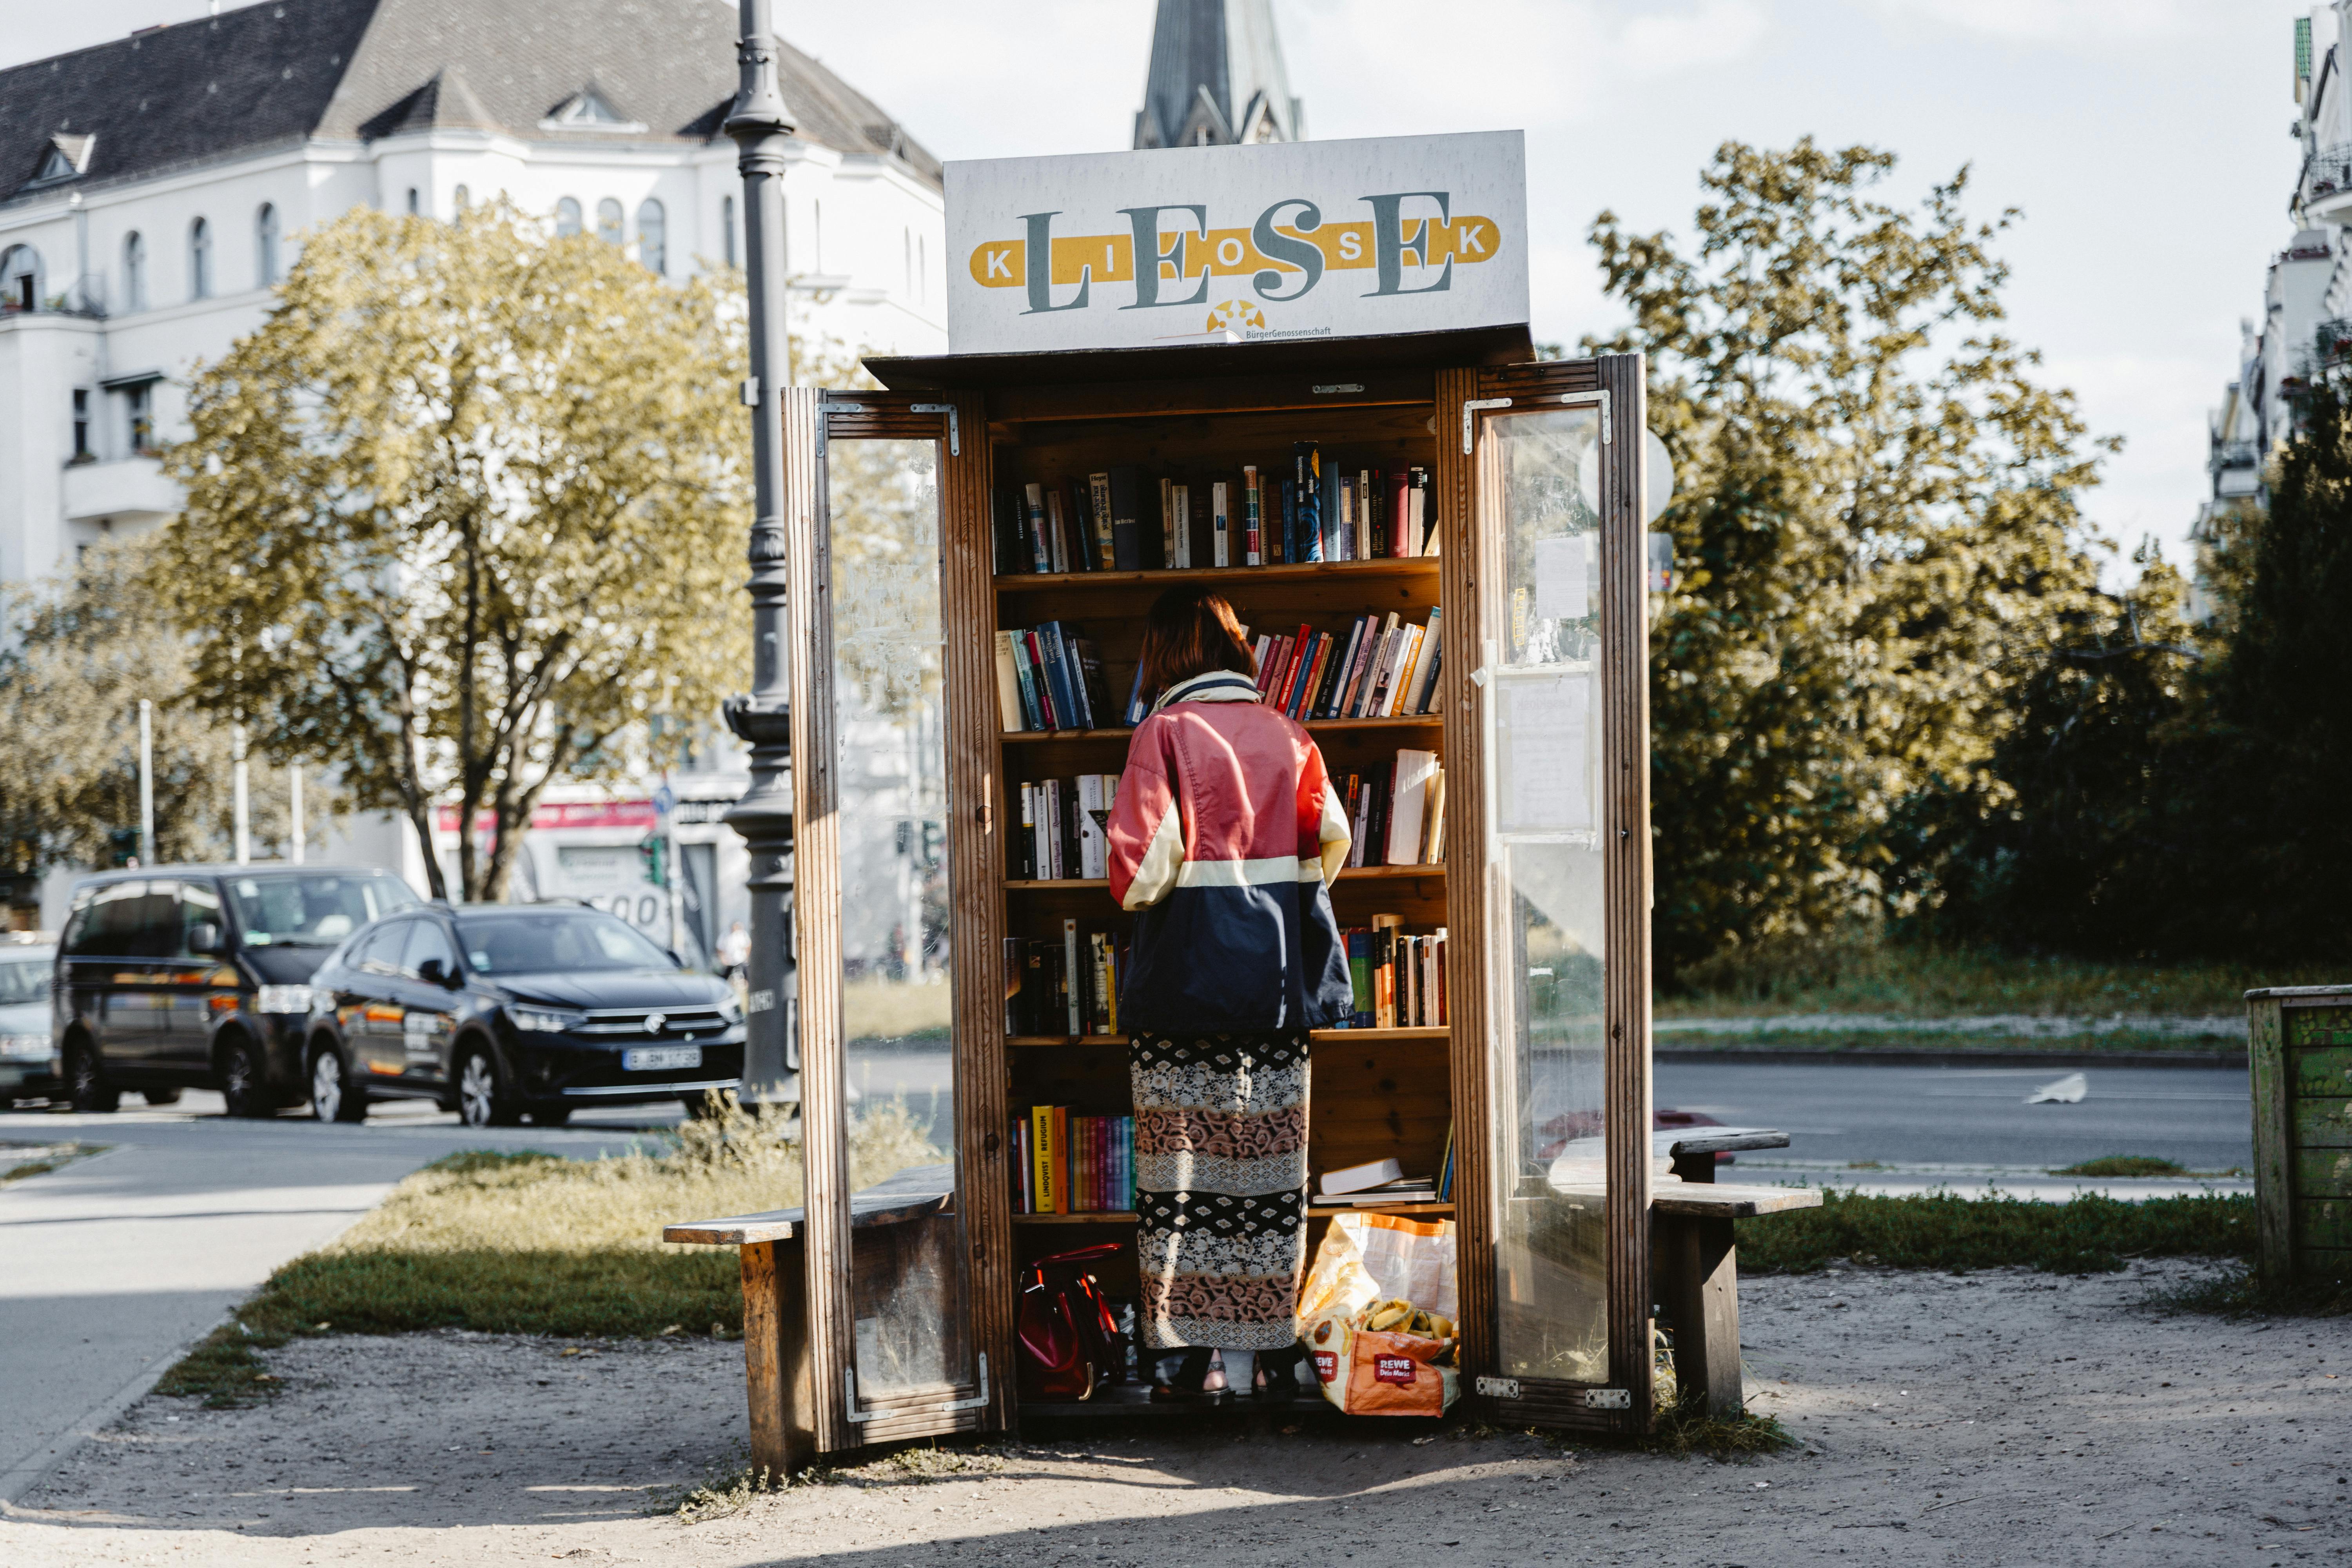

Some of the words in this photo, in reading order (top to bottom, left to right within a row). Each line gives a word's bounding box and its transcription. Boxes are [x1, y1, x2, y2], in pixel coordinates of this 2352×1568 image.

[1016, 191, 1451, 315] LESE
[1247, 327, 1331, 340] BürgerGenossenschaft
[1363, 637, 1372, 653] Wüste!
[1426, 625, 1438, 645] GOOD
[1045, 631, 1056, 663] Entdeckung
[1274, 649, 1289, 680] Skandale
[1287, 670, 1295, 685] kommen
[1398, 675, 1409, 699] Freiheitsstatue
[1410, 674, 1424, 703] PARENT
[1380, 1369, 1394, 1377] Dein
[1381, 1360, 1410, 1369] REWE
